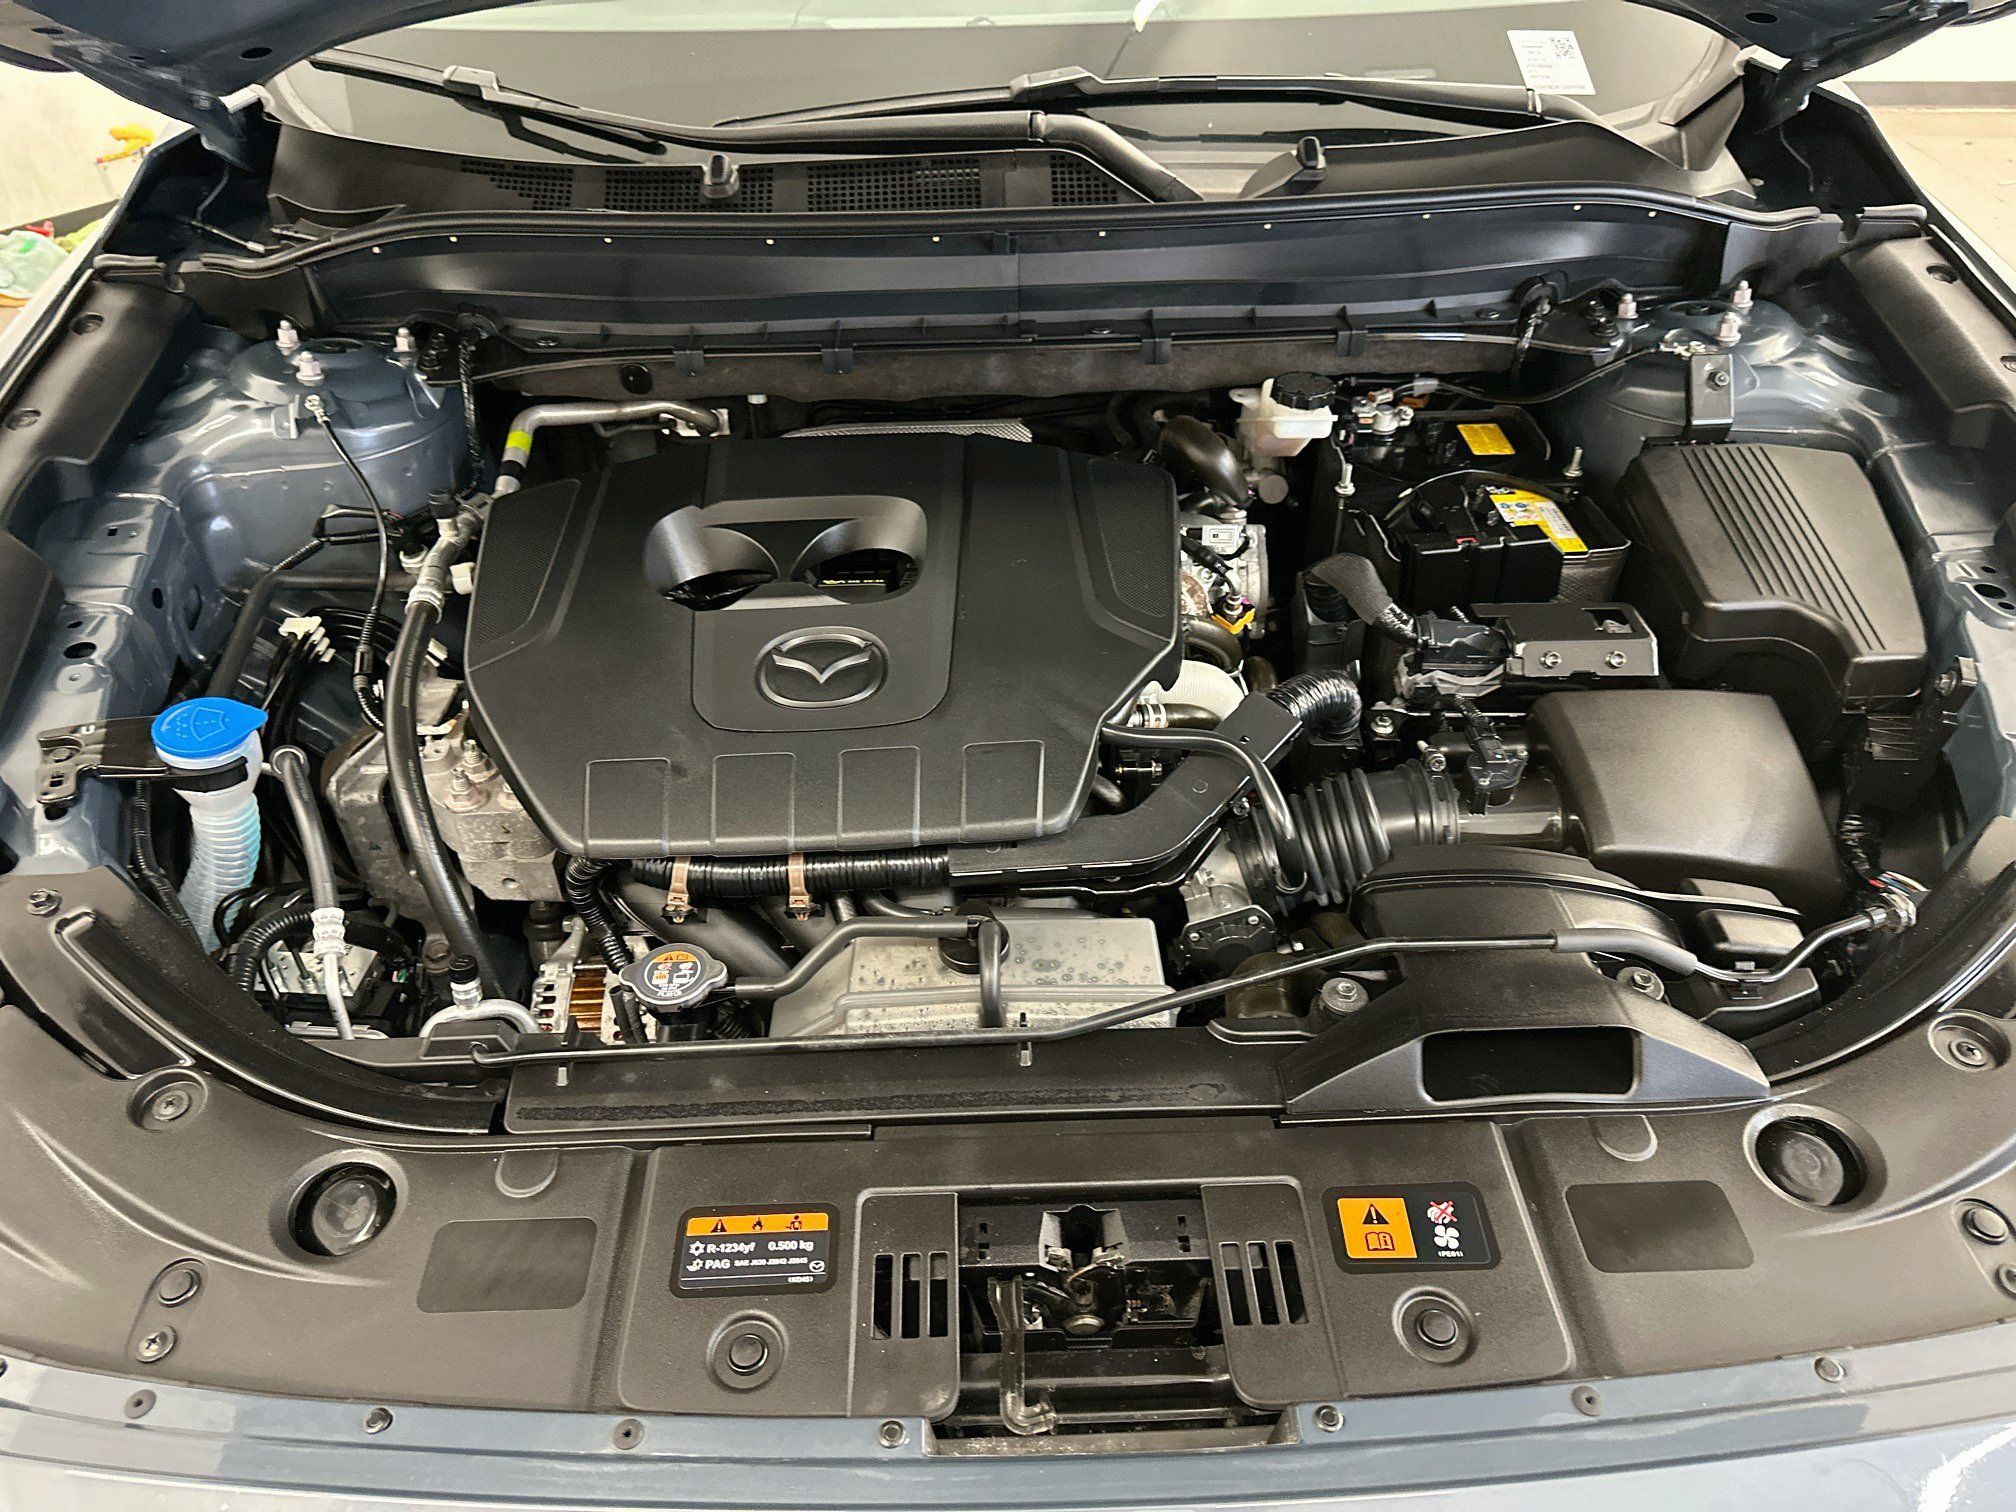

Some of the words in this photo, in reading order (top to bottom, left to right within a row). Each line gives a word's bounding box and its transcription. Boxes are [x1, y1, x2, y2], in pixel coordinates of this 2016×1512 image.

[707, 1242, 755, 1254] R-1234yf
[768, 1241, 797, 1251] 0.500
[799, 1240, 814, 1251] kg
[705, 1259, 730, 1269] PAG
